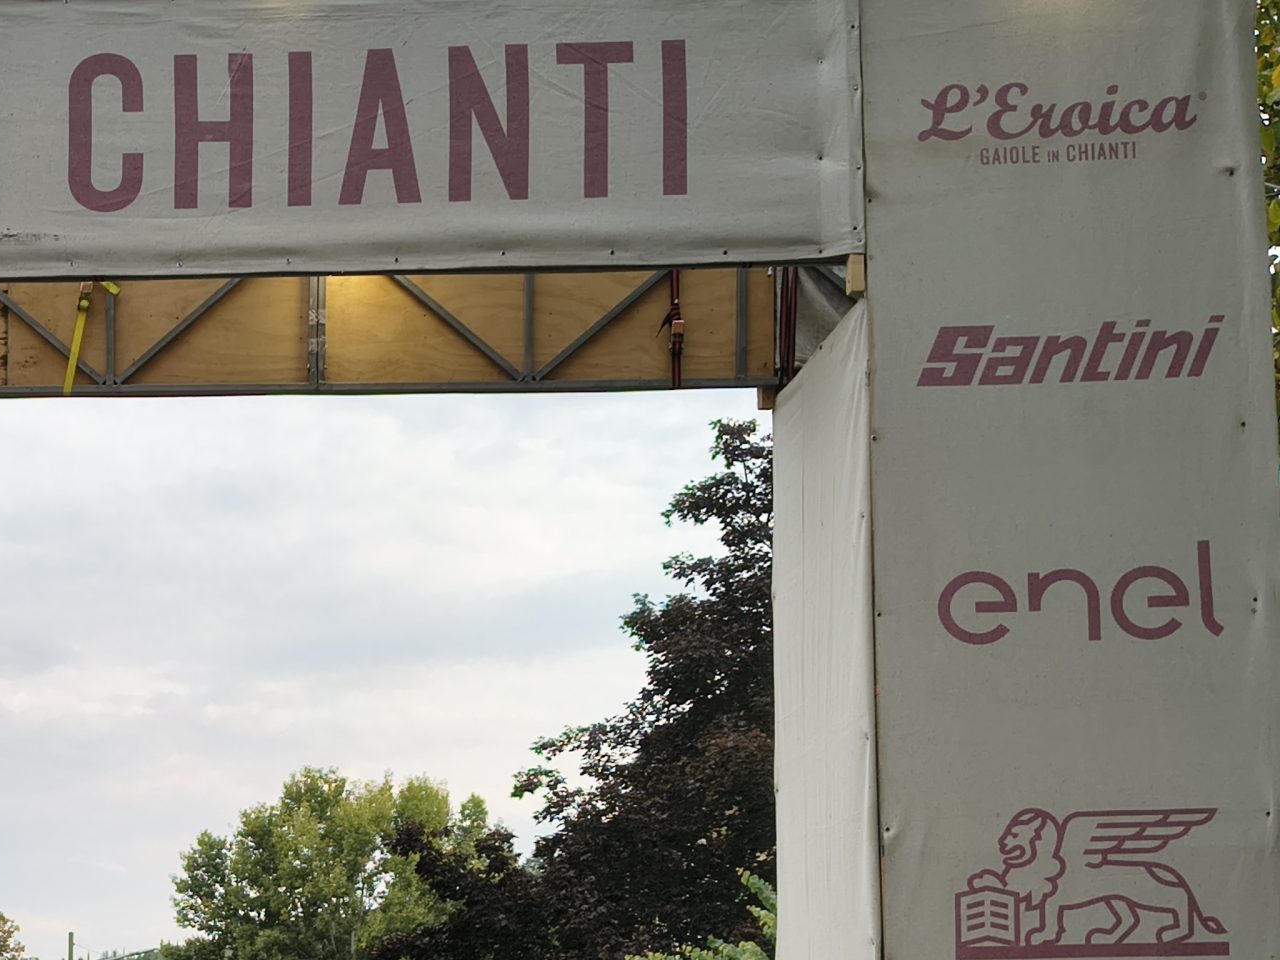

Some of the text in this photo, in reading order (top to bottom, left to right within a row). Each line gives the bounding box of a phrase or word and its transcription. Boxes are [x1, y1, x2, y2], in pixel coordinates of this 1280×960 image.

[67, 39, 689, 213] CHIANTI
[918, 82, 1199, 142] L'Eroica
[979, 141, 1138, 166] GAIOLE IN CHIANTI
[916, 314, 1225, 387] Santini
[937, 540, 1224, 646] enel
